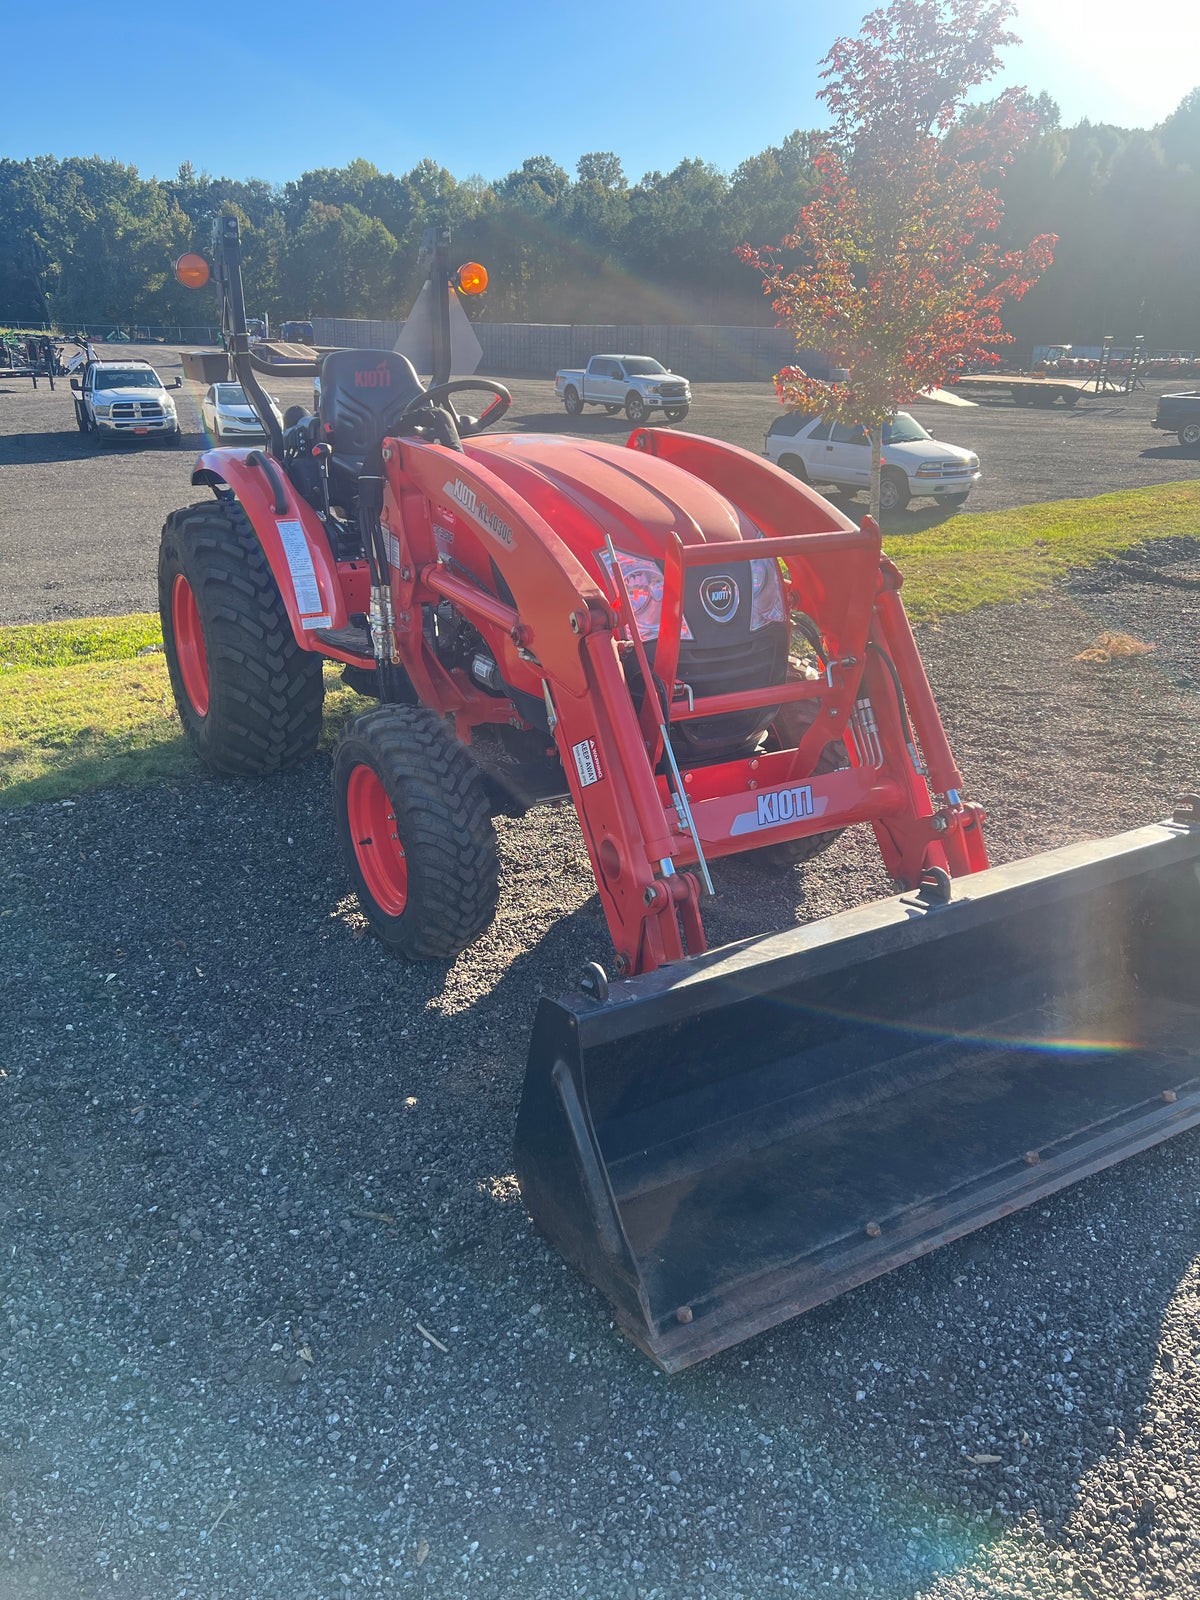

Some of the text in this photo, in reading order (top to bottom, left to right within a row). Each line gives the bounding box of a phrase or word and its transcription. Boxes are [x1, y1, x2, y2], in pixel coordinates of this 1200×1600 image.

[354, 370, 391, 388] KIOTI
[453, 477, 477, 514] KIOTI
[478, 501, 513, 545] KL4030C
[711, 590, 729, 602] KIOTI
[581, 742, 595, 781] KEEP AWAY
[592, 748, 603, 778] WARNING
[757, 784, 814, 826] KIOTI
